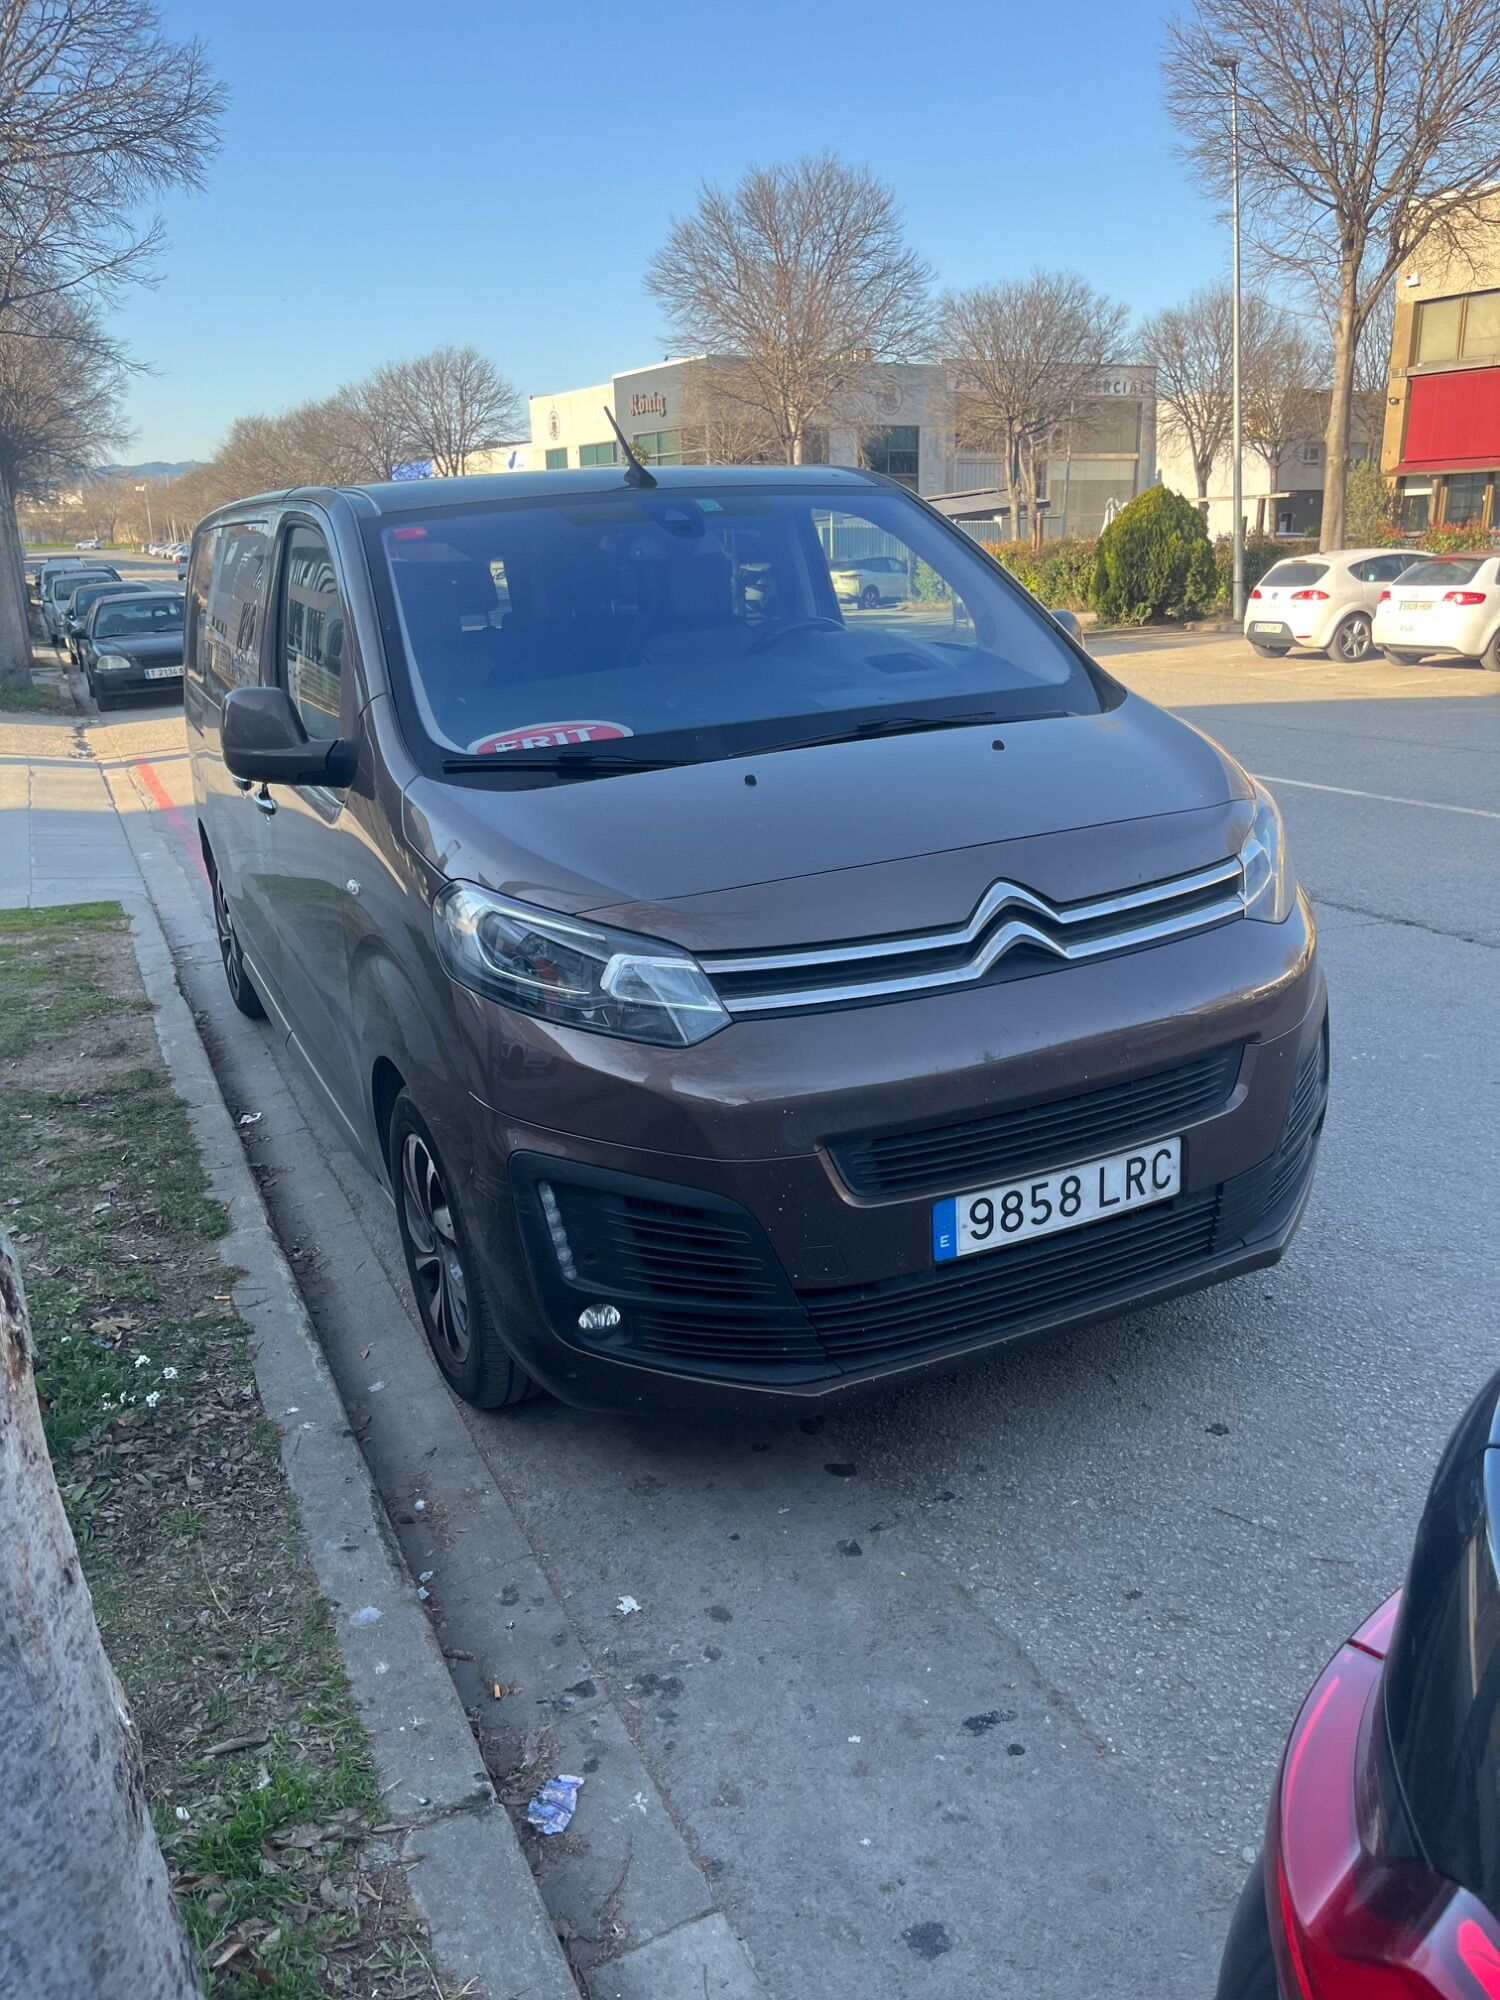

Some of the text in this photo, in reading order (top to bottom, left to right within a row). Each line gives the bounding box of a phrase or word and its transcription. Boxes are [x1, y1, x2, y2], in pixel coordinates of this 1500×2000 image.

[969, 1149, 1172, 1240] 9858 LRC
[940, 1235, 949, 1248] E
